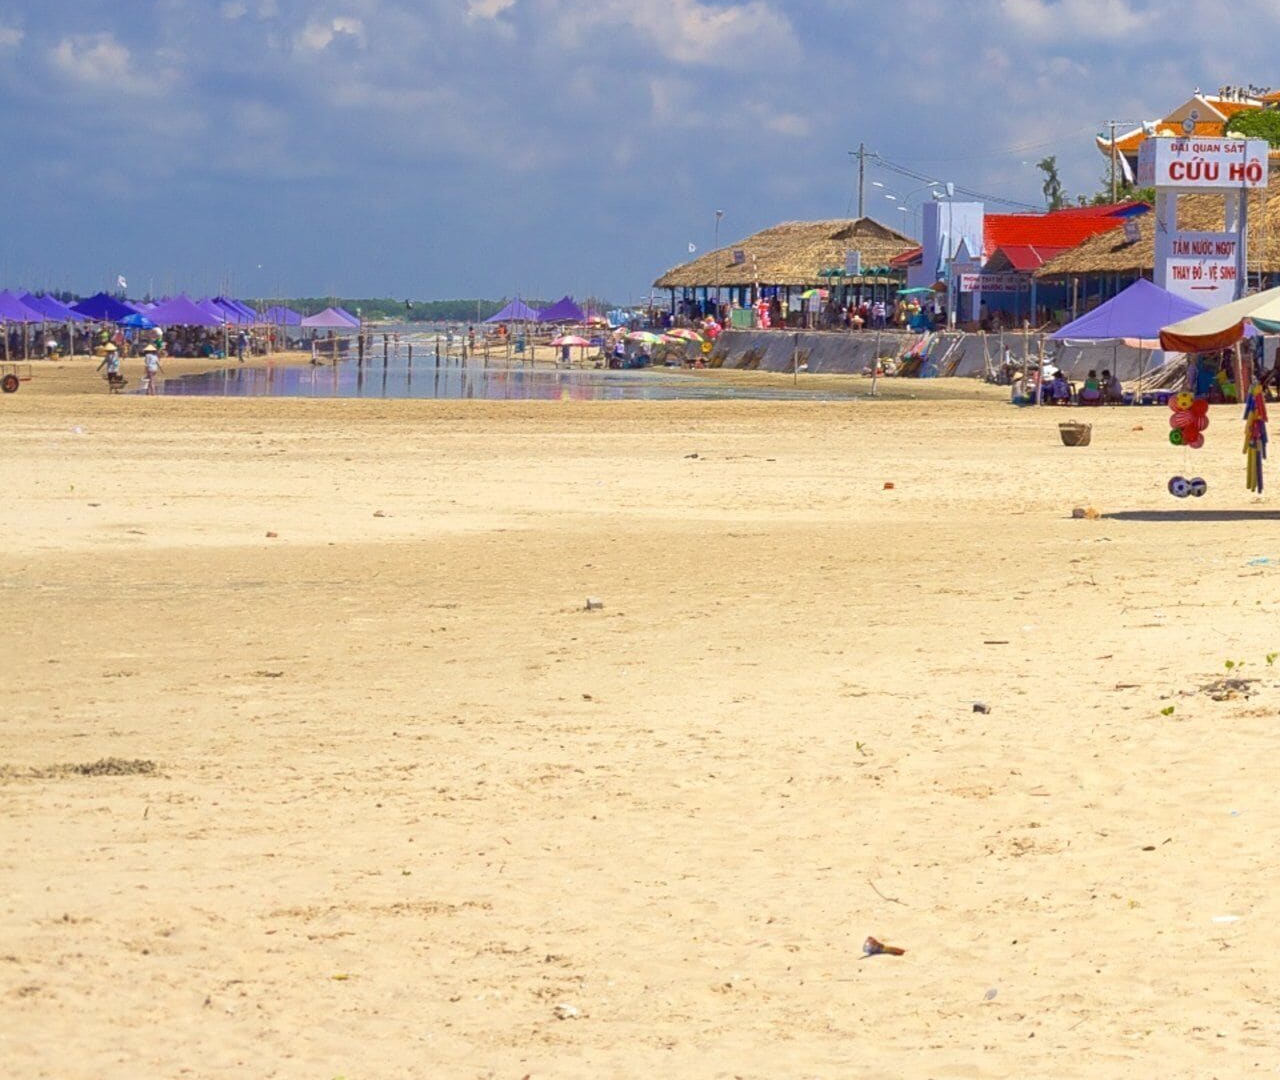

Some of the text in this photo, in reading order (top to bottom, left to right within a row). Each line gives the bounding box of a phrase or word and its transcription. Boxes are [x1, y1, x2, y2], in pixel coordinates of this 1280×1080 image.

[1193, 143, 1220, 153] QUAN
[1169, 156, 1219, 181] CỨU
[1229, 158, 1262, 185] HỘ
[1172, 266, 1191, 280] THAY
[1220, 266, 1237, 280] SINH
